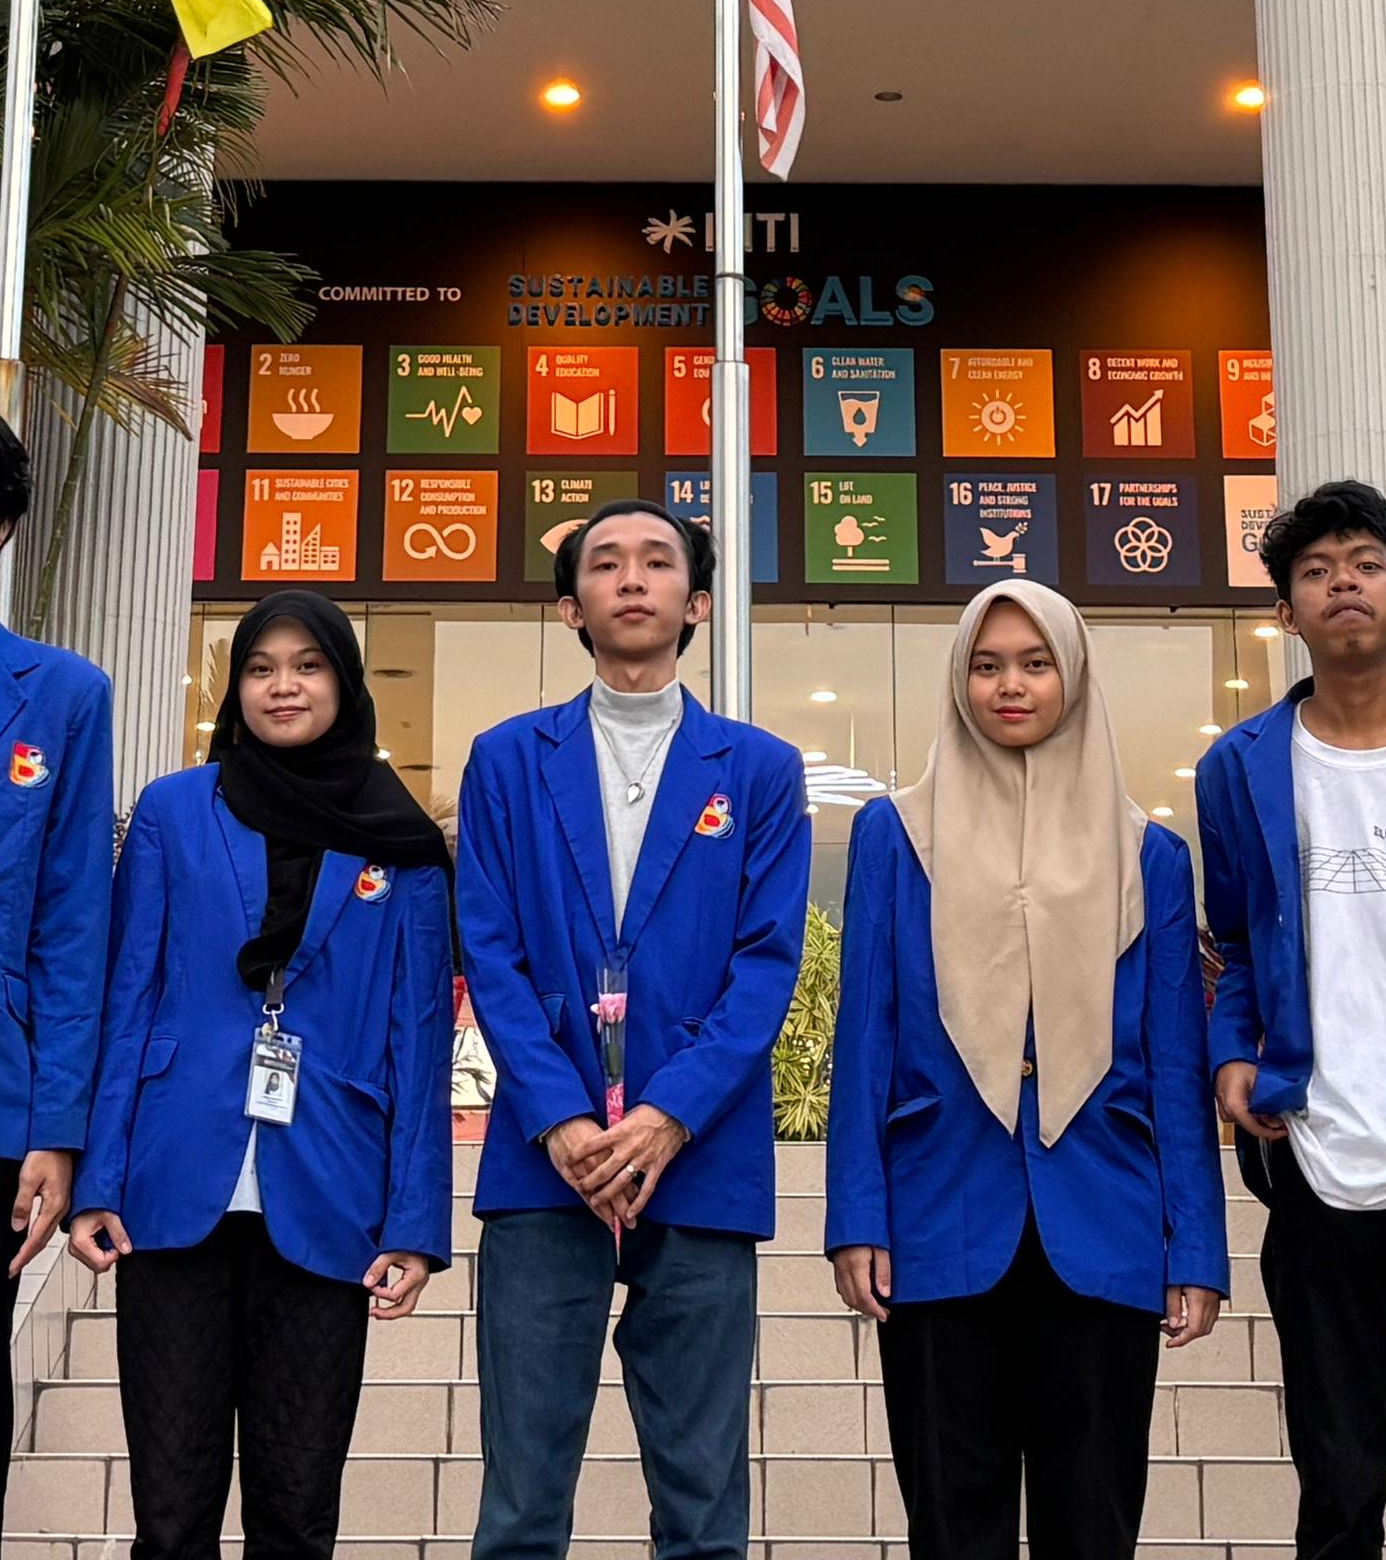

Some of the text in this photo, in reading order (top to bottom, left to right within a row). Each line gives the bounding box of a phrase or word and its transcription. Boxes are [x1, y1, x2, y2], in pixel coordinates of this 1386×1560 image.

[705, 212, 799, 253] ITI
[318, 286, 462, 301] COMMITTED TO
[509, 274, 710, 298] SUSTAINABLE
[507, 303, 710, 327] DEVELOPMENT
[258, 353, 273, 376] 2
[396, 353, 411, 376] 3
[535, 354, 549, 377] 4
[673, 355, 686, 378] 5
[693, 355, 715, 365] GEND
[811, 356, 825, 379] 6
[949, 357, 960, 380] 7
[1088, 357, 1101, 380] 8
[1226, 359, 1240, 382] 9
[252, 478, 270, 501] 11
[391, 479, 414, 501] 12
[532, 479, 554, 503] 13
[561, 493, 589, 502] ACTION
[670, 480, 693, 503] 14
[810, 481, 833, 504] 15
[949, 482, 973, 505] 16
[1090, 483, 1111, 506] 17
